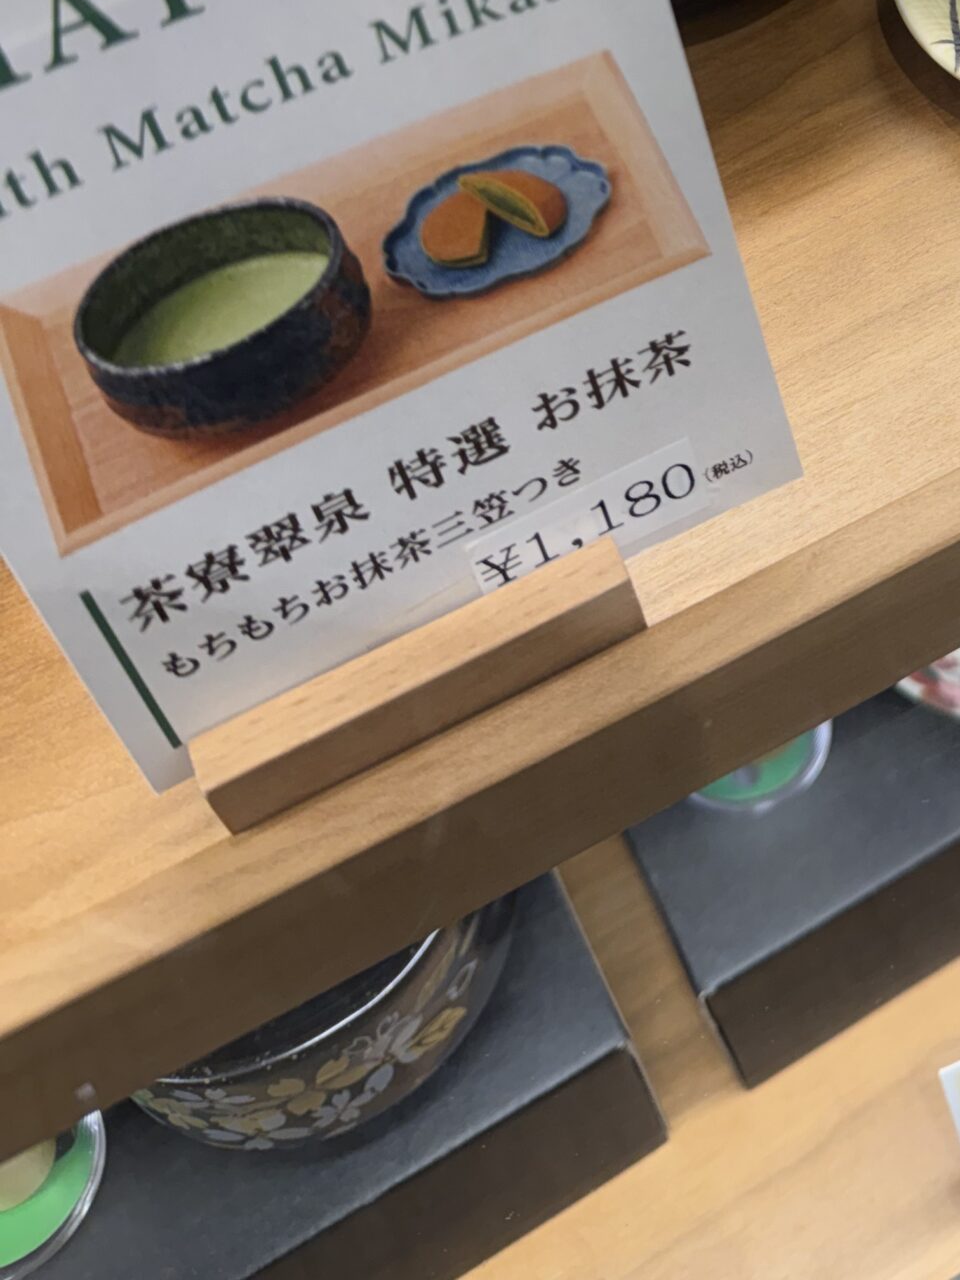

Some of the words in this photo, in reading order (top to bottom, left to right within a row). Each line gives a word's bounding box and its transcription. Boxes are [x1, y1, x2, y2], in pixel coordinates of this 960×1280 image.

[0, 150, 84, 218] th
[98, 51, 353, 171] Matcha
[120, 487, 370, 632] 茶寮翠泉
[388, 417, 511, 501] 特選
[531, 330, 694, 431] お抹茶
[161, 457, 583, 679] もちもちお抹茶三笠つき
